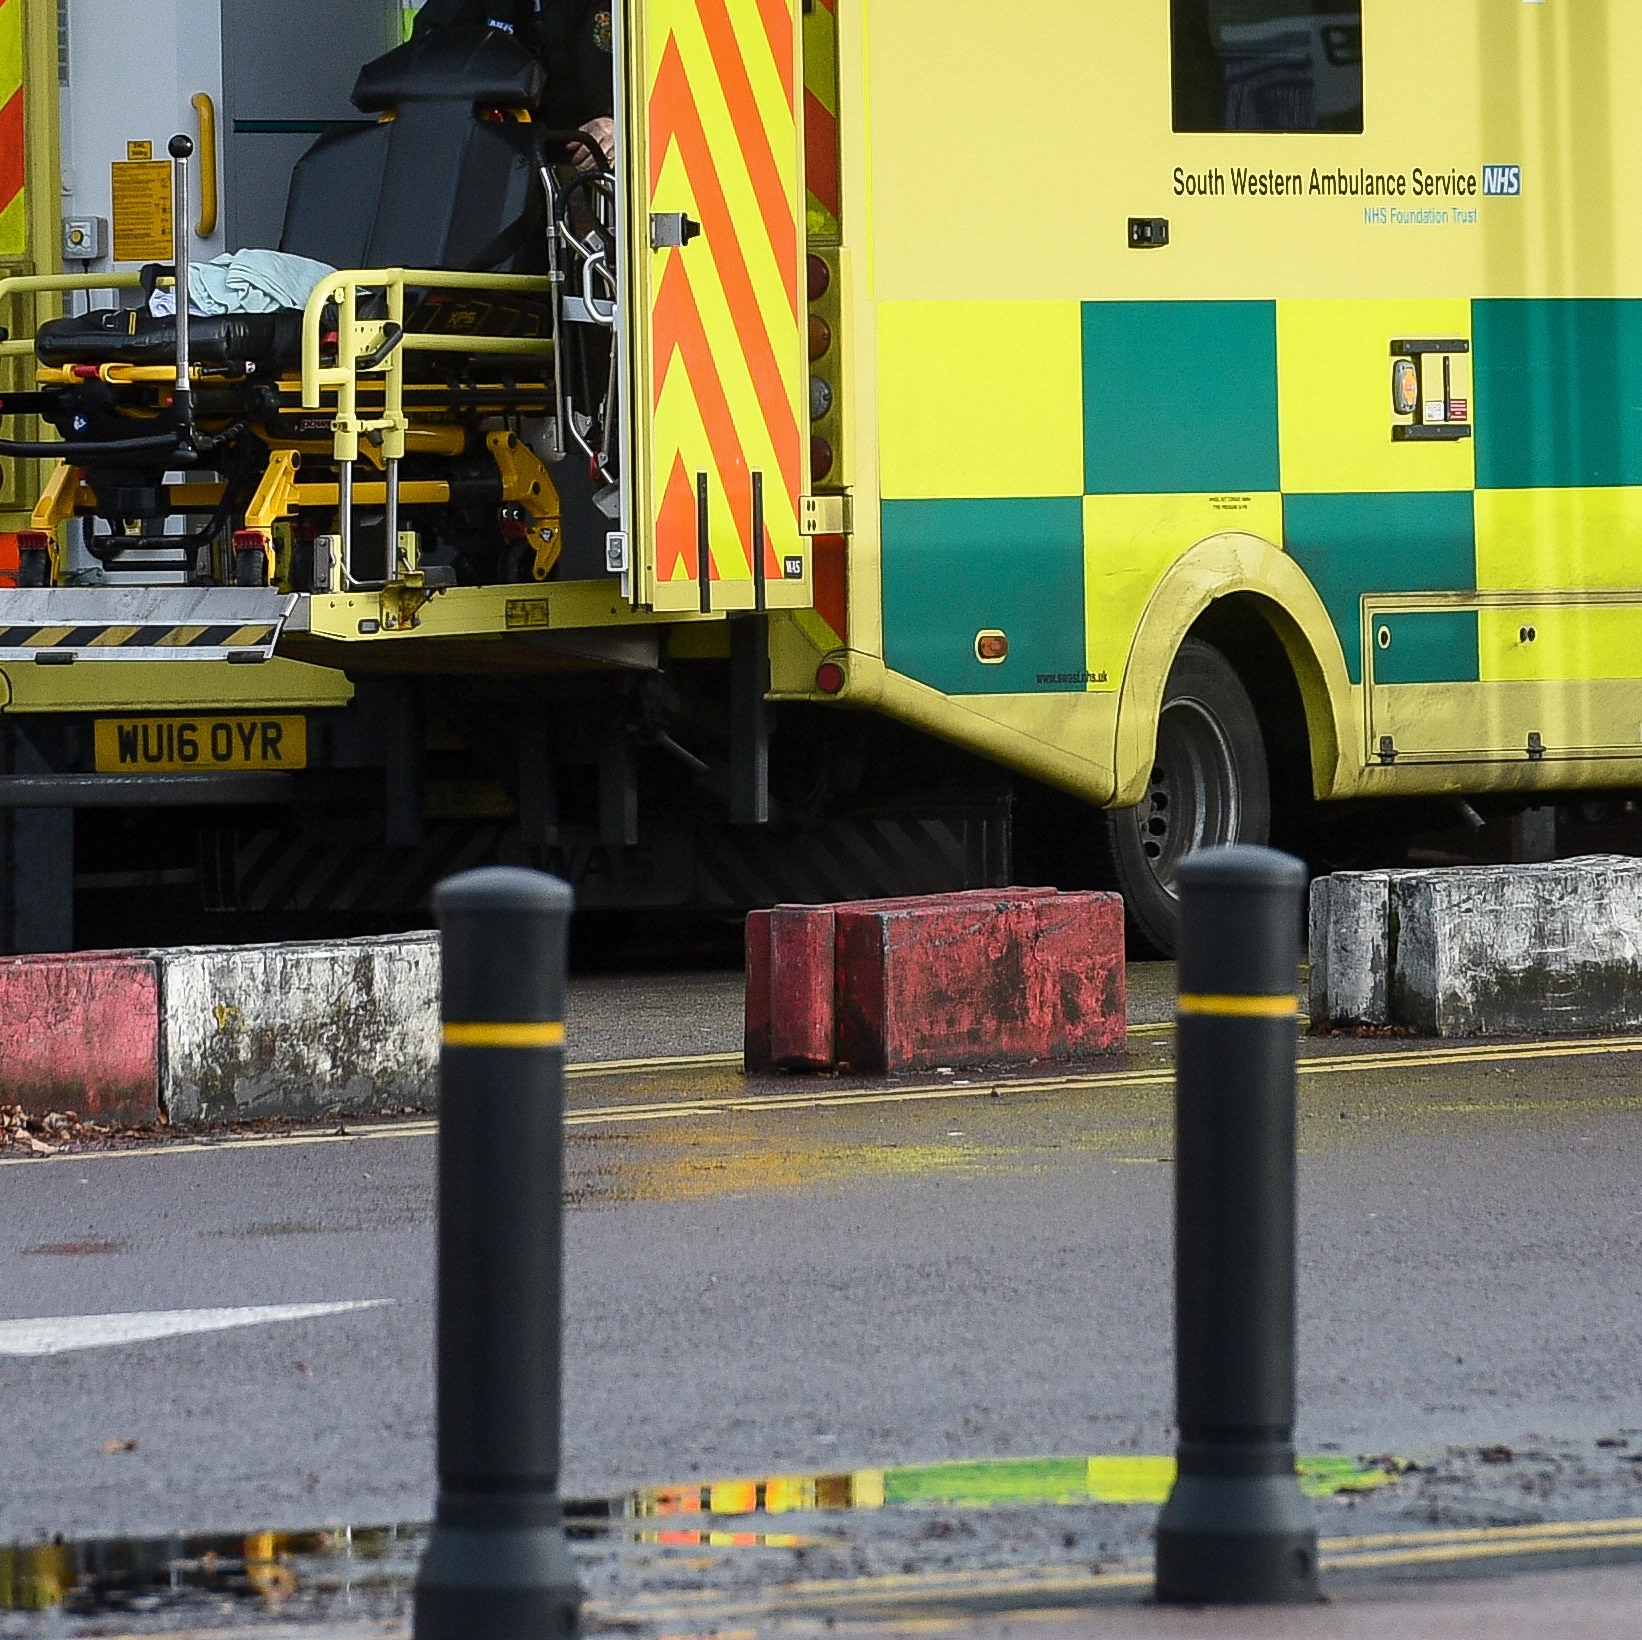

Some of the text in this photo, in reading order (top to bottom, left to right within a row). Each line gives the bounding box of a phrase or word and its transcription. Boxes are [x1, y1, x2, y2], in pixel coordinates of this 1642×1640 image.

[1173, 166, 1520, 197] South Western Ambulance Service NHS
[1363, 206, 1478, 224] NHS Foundation Trust
[117, 720, 284, 764] WU16 OYR
